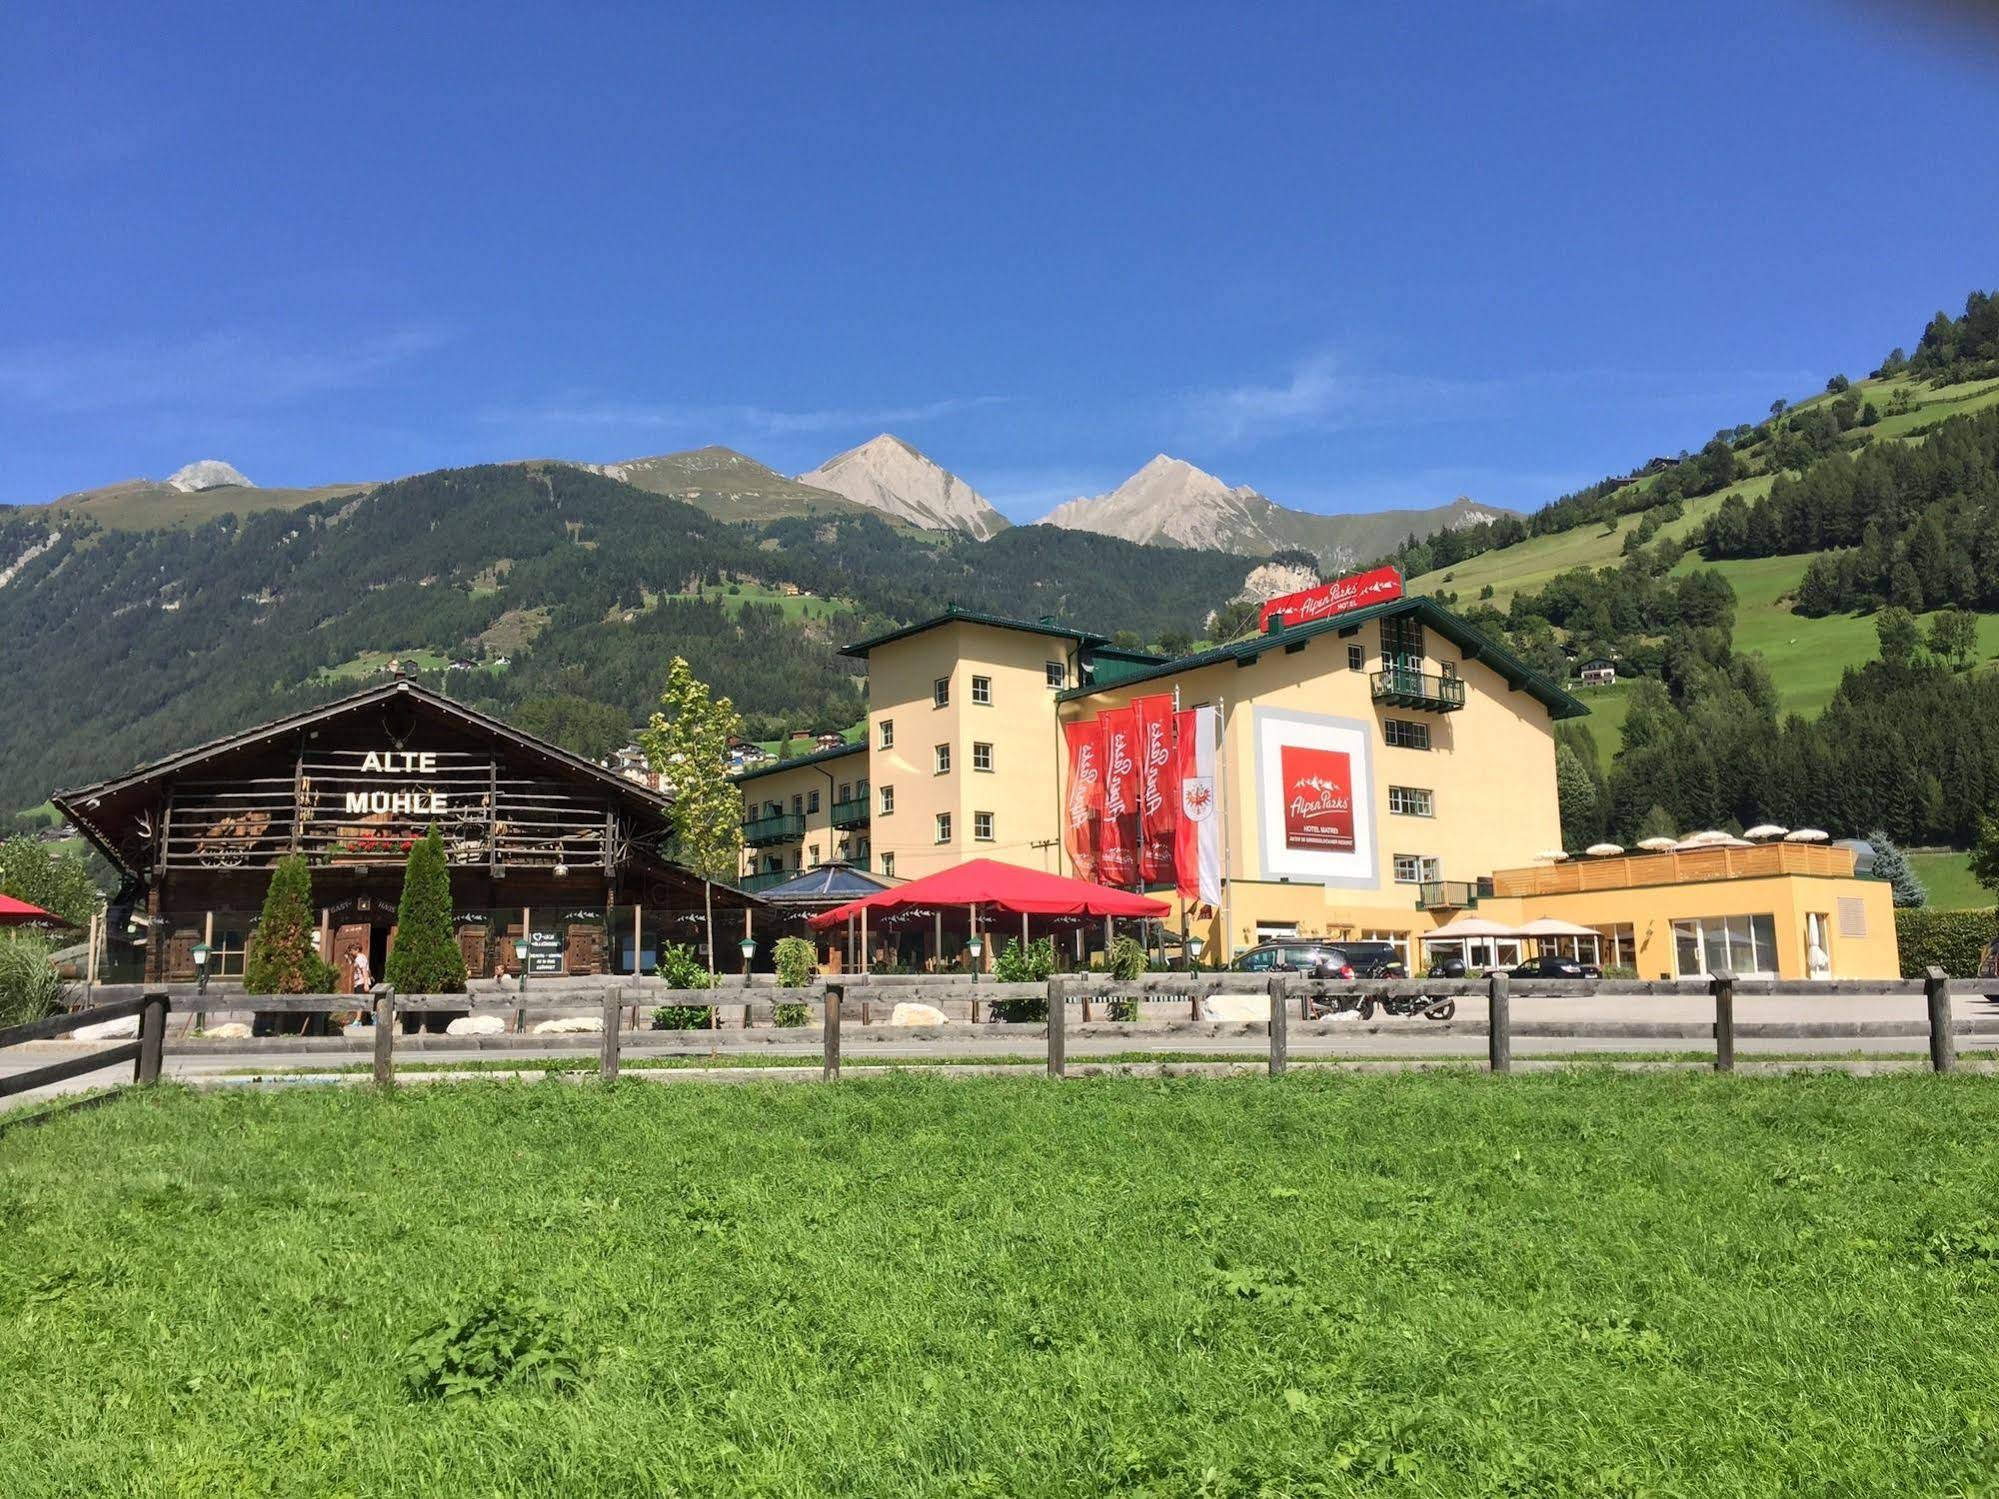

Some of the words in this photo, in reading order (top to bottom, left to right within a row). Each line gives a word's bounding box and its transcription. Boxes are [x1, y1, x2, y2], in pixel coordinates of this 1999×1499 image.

[1300, 597, 1329, 618] Alpen
[1329, 583, 1357, 602] Parks
[360, 750, 437, 773] ALTE
[345, 791, 448, 814] MÜHLE
[1290, 795, 1321, 818] Alpen
[1320, 790, 1348, 809] Parks
